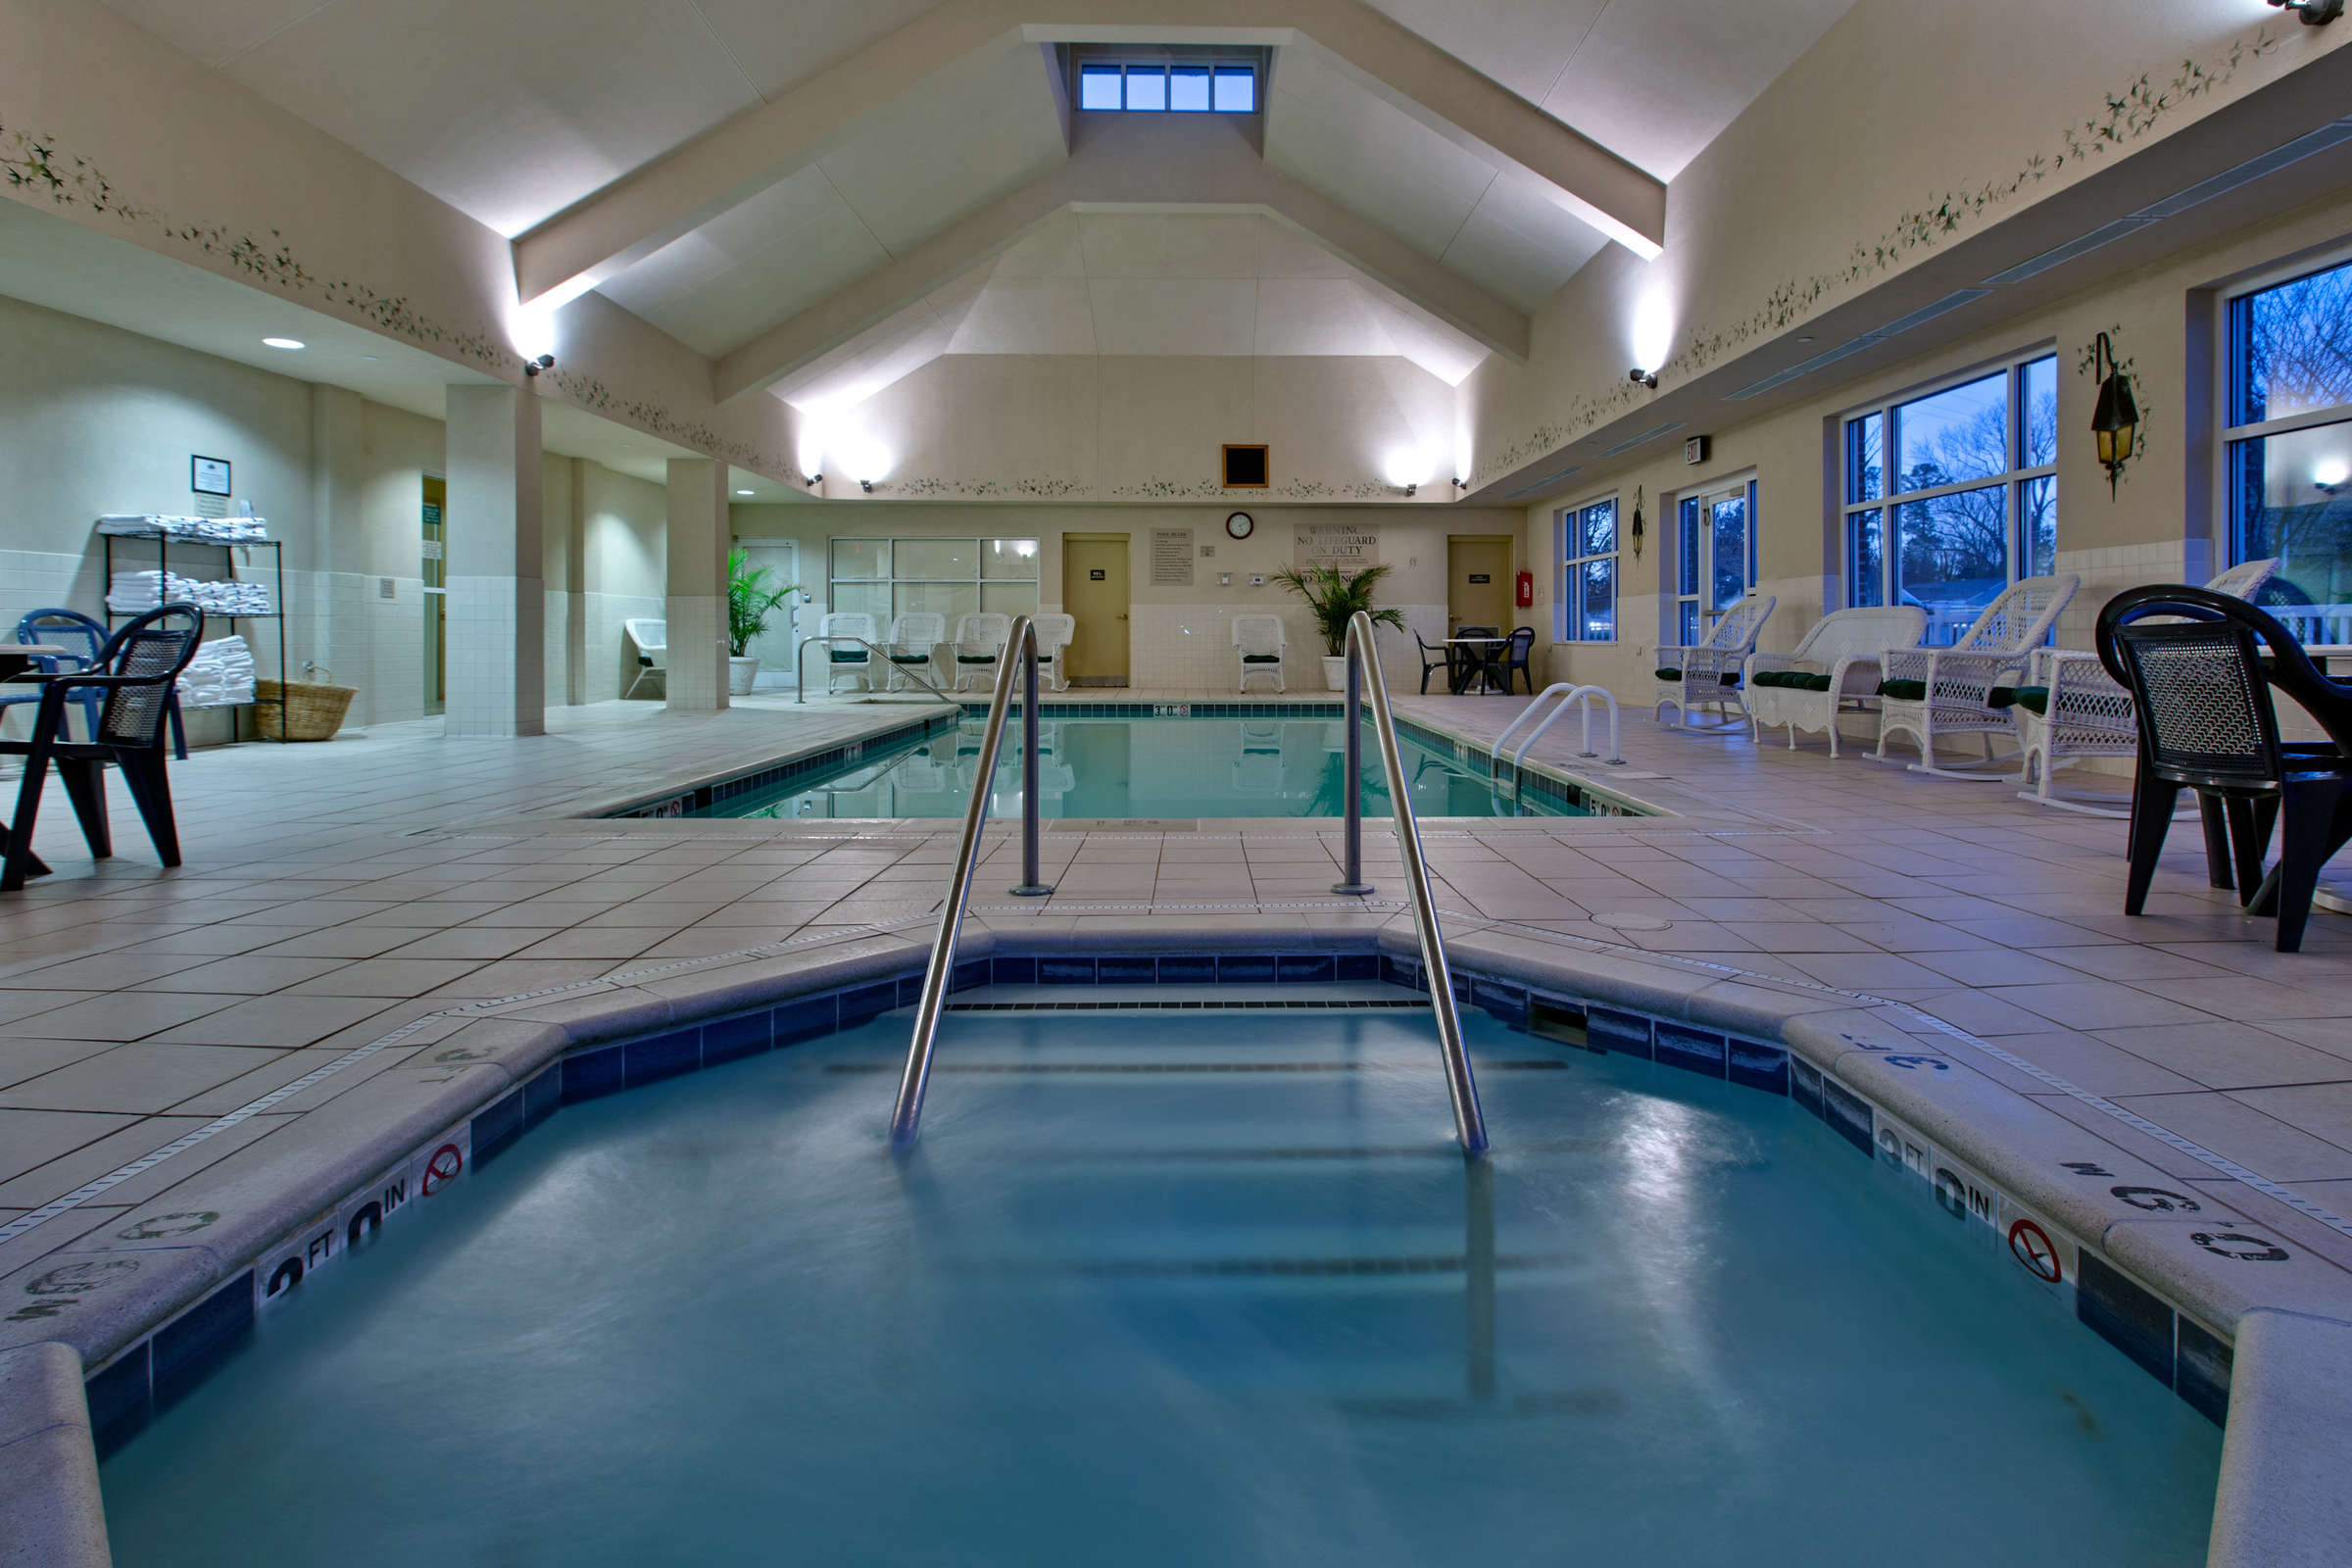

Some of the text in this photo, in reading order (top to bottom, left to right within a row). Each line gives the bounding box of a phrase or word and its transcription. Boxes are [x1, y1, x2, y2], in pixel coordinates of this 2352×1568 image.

[1687, 441, 1697, 462] EXIT
[1298, 536, 1377, 545] NO LIFEGUARD
[1332, 546, 1362, 555] DUTY
[1904, 1142, 1924, 1172] FT
[1968, 1184, 1989, 1222] IN
[308, 1228, 335, 1269] FT
[384, 1178, 406, 1214] IN
